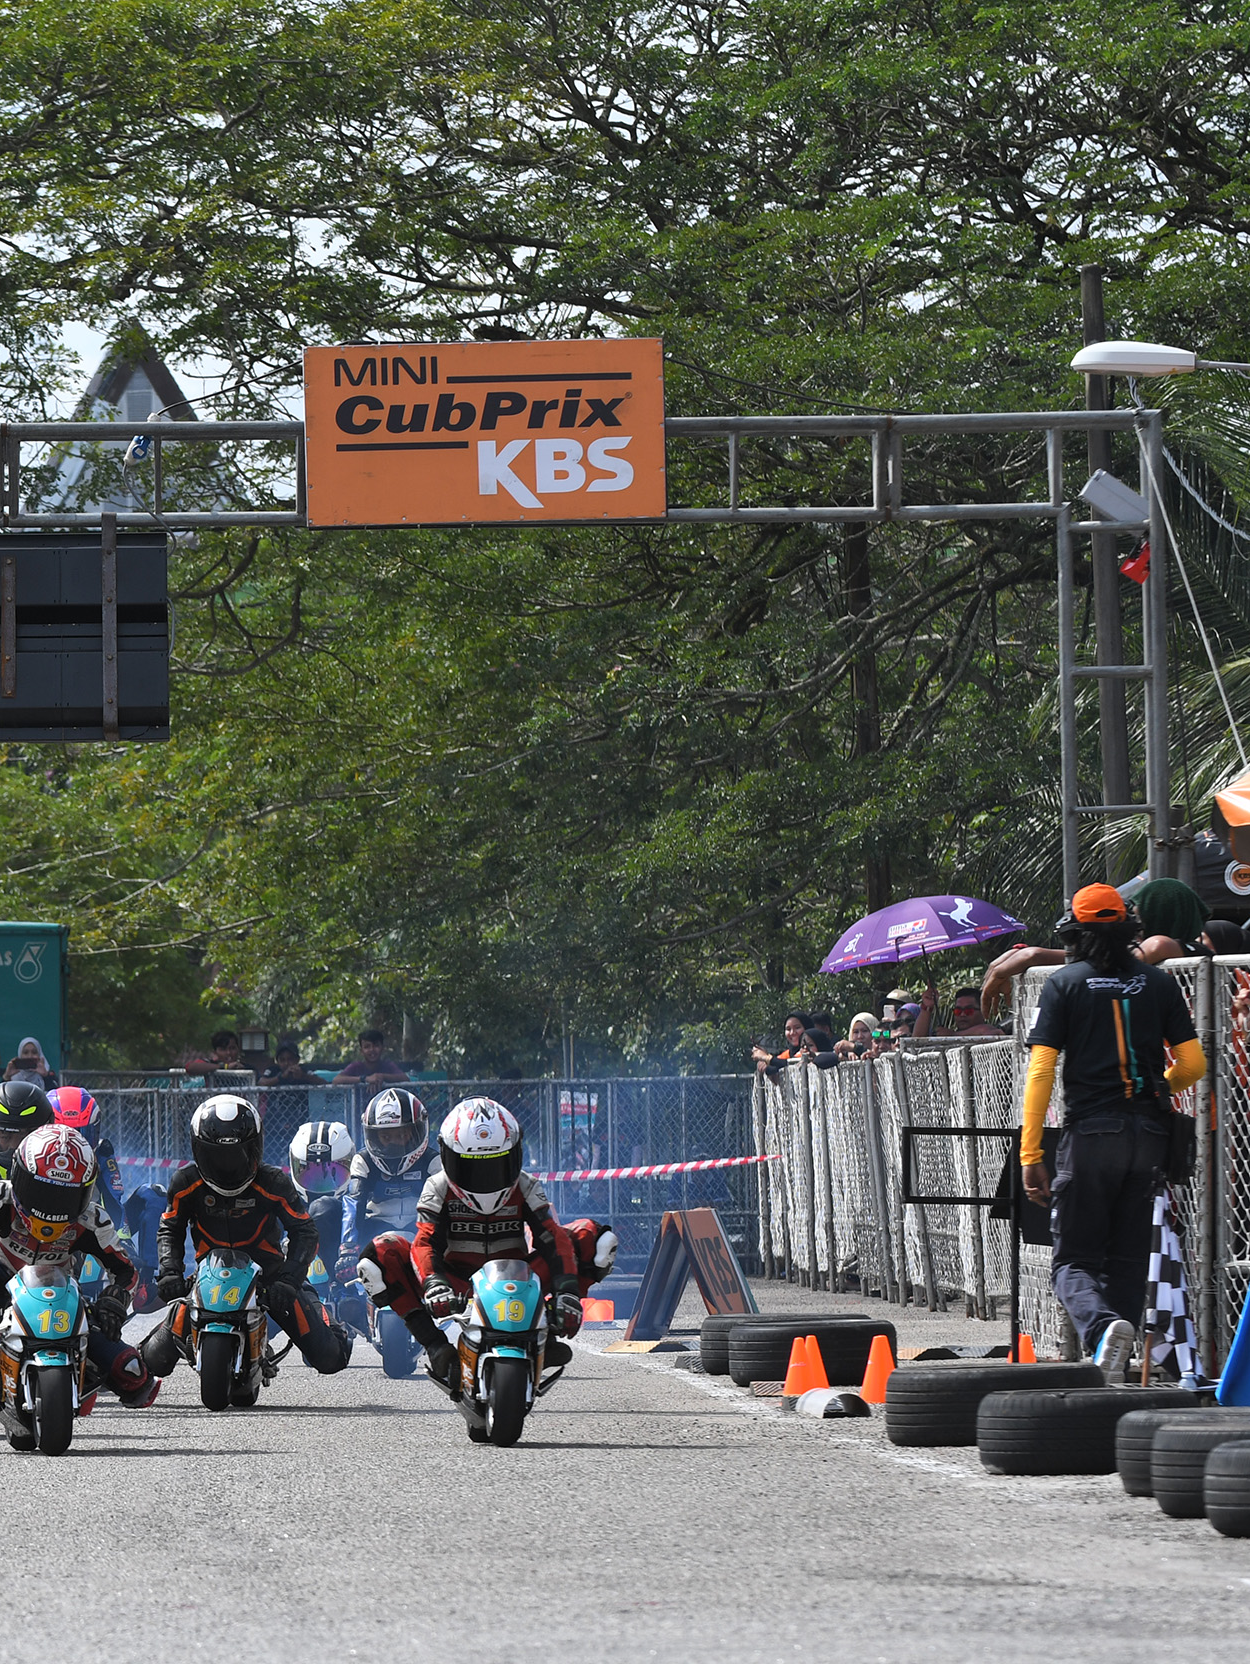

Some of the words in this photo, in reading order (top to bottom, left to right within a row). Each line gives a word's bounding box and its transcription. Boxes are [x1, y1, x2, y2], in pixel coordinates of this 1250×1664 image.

[333, 356, 438, 387] MINI
[335, 388, 626, 435] CubPrix
[477, 435, 634, 508] KBS
[50, 1170, 71, 1180] SHOEI
[31, 1208, 46, 1219] PULL
[209, 1284, 240, 1306] 14
[37, 1308, 71, 1334] 13
[493, 1299, 525, 1323] 19
